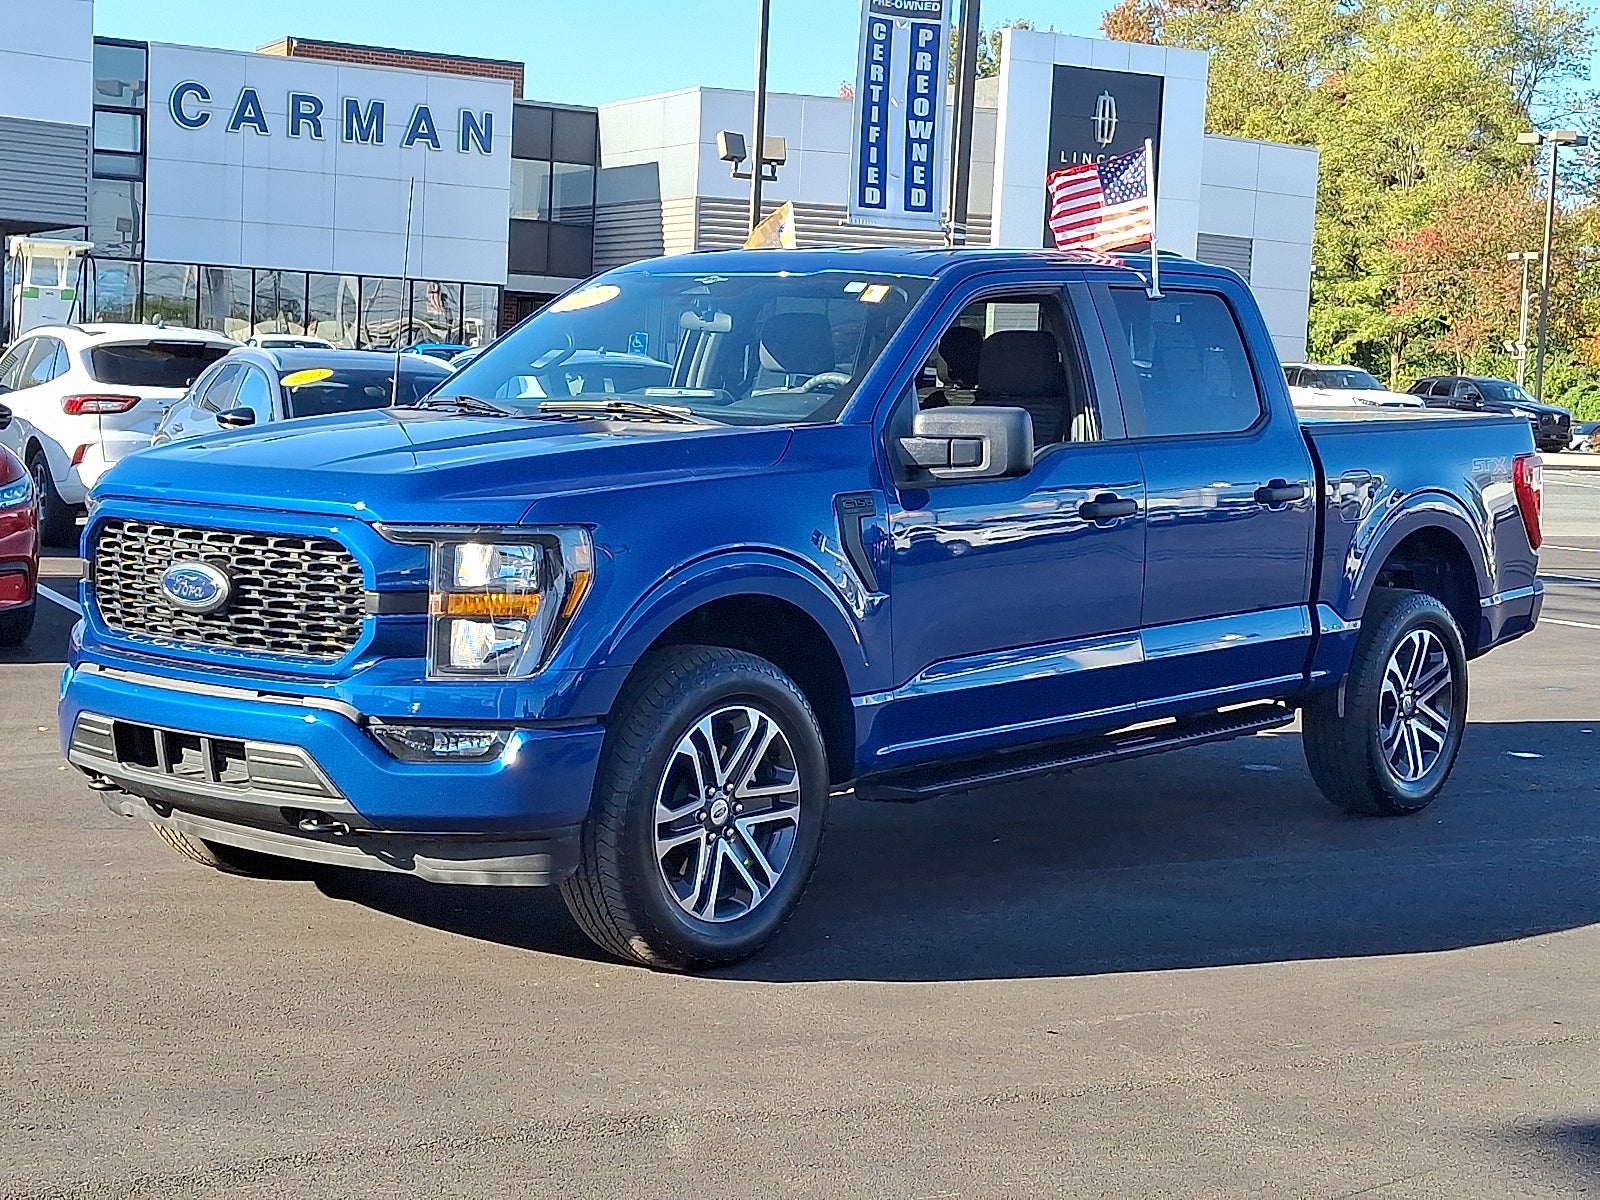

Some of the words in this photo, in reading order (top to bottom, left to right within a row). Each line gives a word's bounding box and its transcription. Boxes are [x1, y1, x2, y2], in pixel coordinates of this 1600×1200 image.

[169, 80, 495, 155] CARMAN
[863, 22, 887, 205] CERTIFIED
[908, 28, 934, 207] PREOWNED
[1060, 150, 1118, 164] LINC
[1471, 457, 1508, 475] STX
[172, 574, 206, 597] Ford
